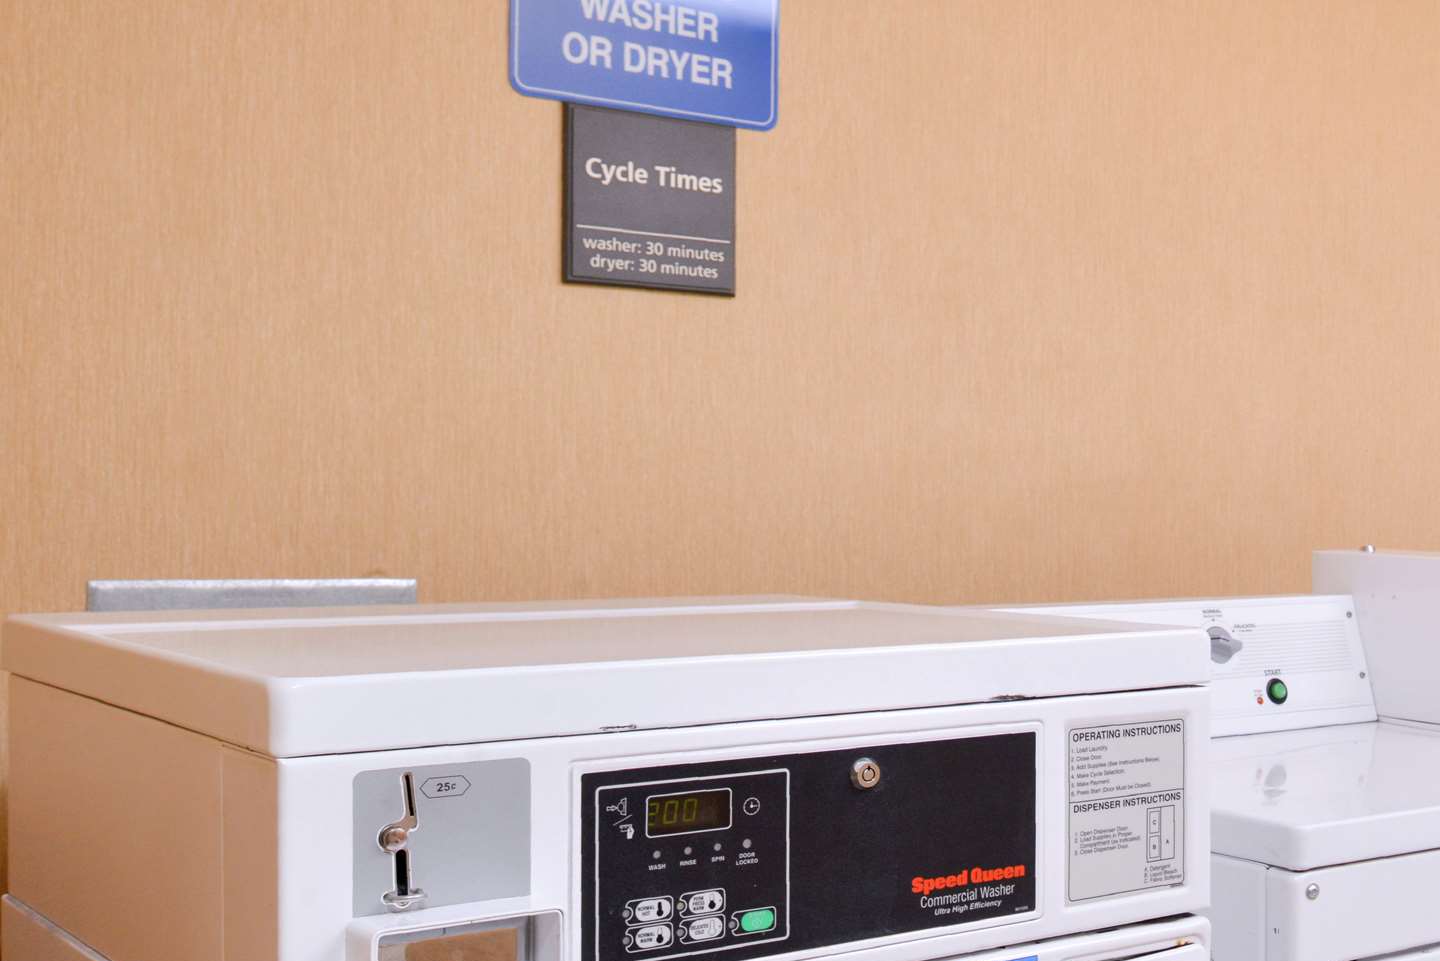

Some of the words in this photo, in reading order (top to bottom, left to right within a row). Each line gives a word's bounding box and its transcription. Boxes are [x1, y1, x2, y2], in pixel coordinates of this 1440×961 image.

[580, 0, 719, 42] WASHER
[562, 31, 612, 69] OR
[623, 43, 733, 89] DRYER
[585, 158, 649, 186] Cycle
[655, 166, 723, 194] Times
[583, 237, 642, 254] washer:
[646, 242, 663, 255] 30
[667, 246, 724, 263] minutes
[590, 255, 634, 272] dryer:
[639, 259, 657, 273] 30
[660, 264, 718, 279] minutes
[1072, 729, 1120, 742] OPERATING
[1122, 723, 1181, 737] INSTRUCTIONS
[1073, 801, 1120, 813] DISPENSER
[1122, 792, 1181, 807] INSTRUCTIONS
[648, 863, 666, 871] WASH
[711, 855, 725, 863] SPIN
[736, 858, 758, 866] LOCKED
[911, 869, 968, 895] Speed
[971, 865, 1025, 883] Queen
[920, 888, 977, 909] Commercial
[980, 884, 1015, 899] Washer
[934, 906, 951, 916] Ultra
[952, 904, 968, 914] High
[969, 900, 1002, 910] Efficiency
